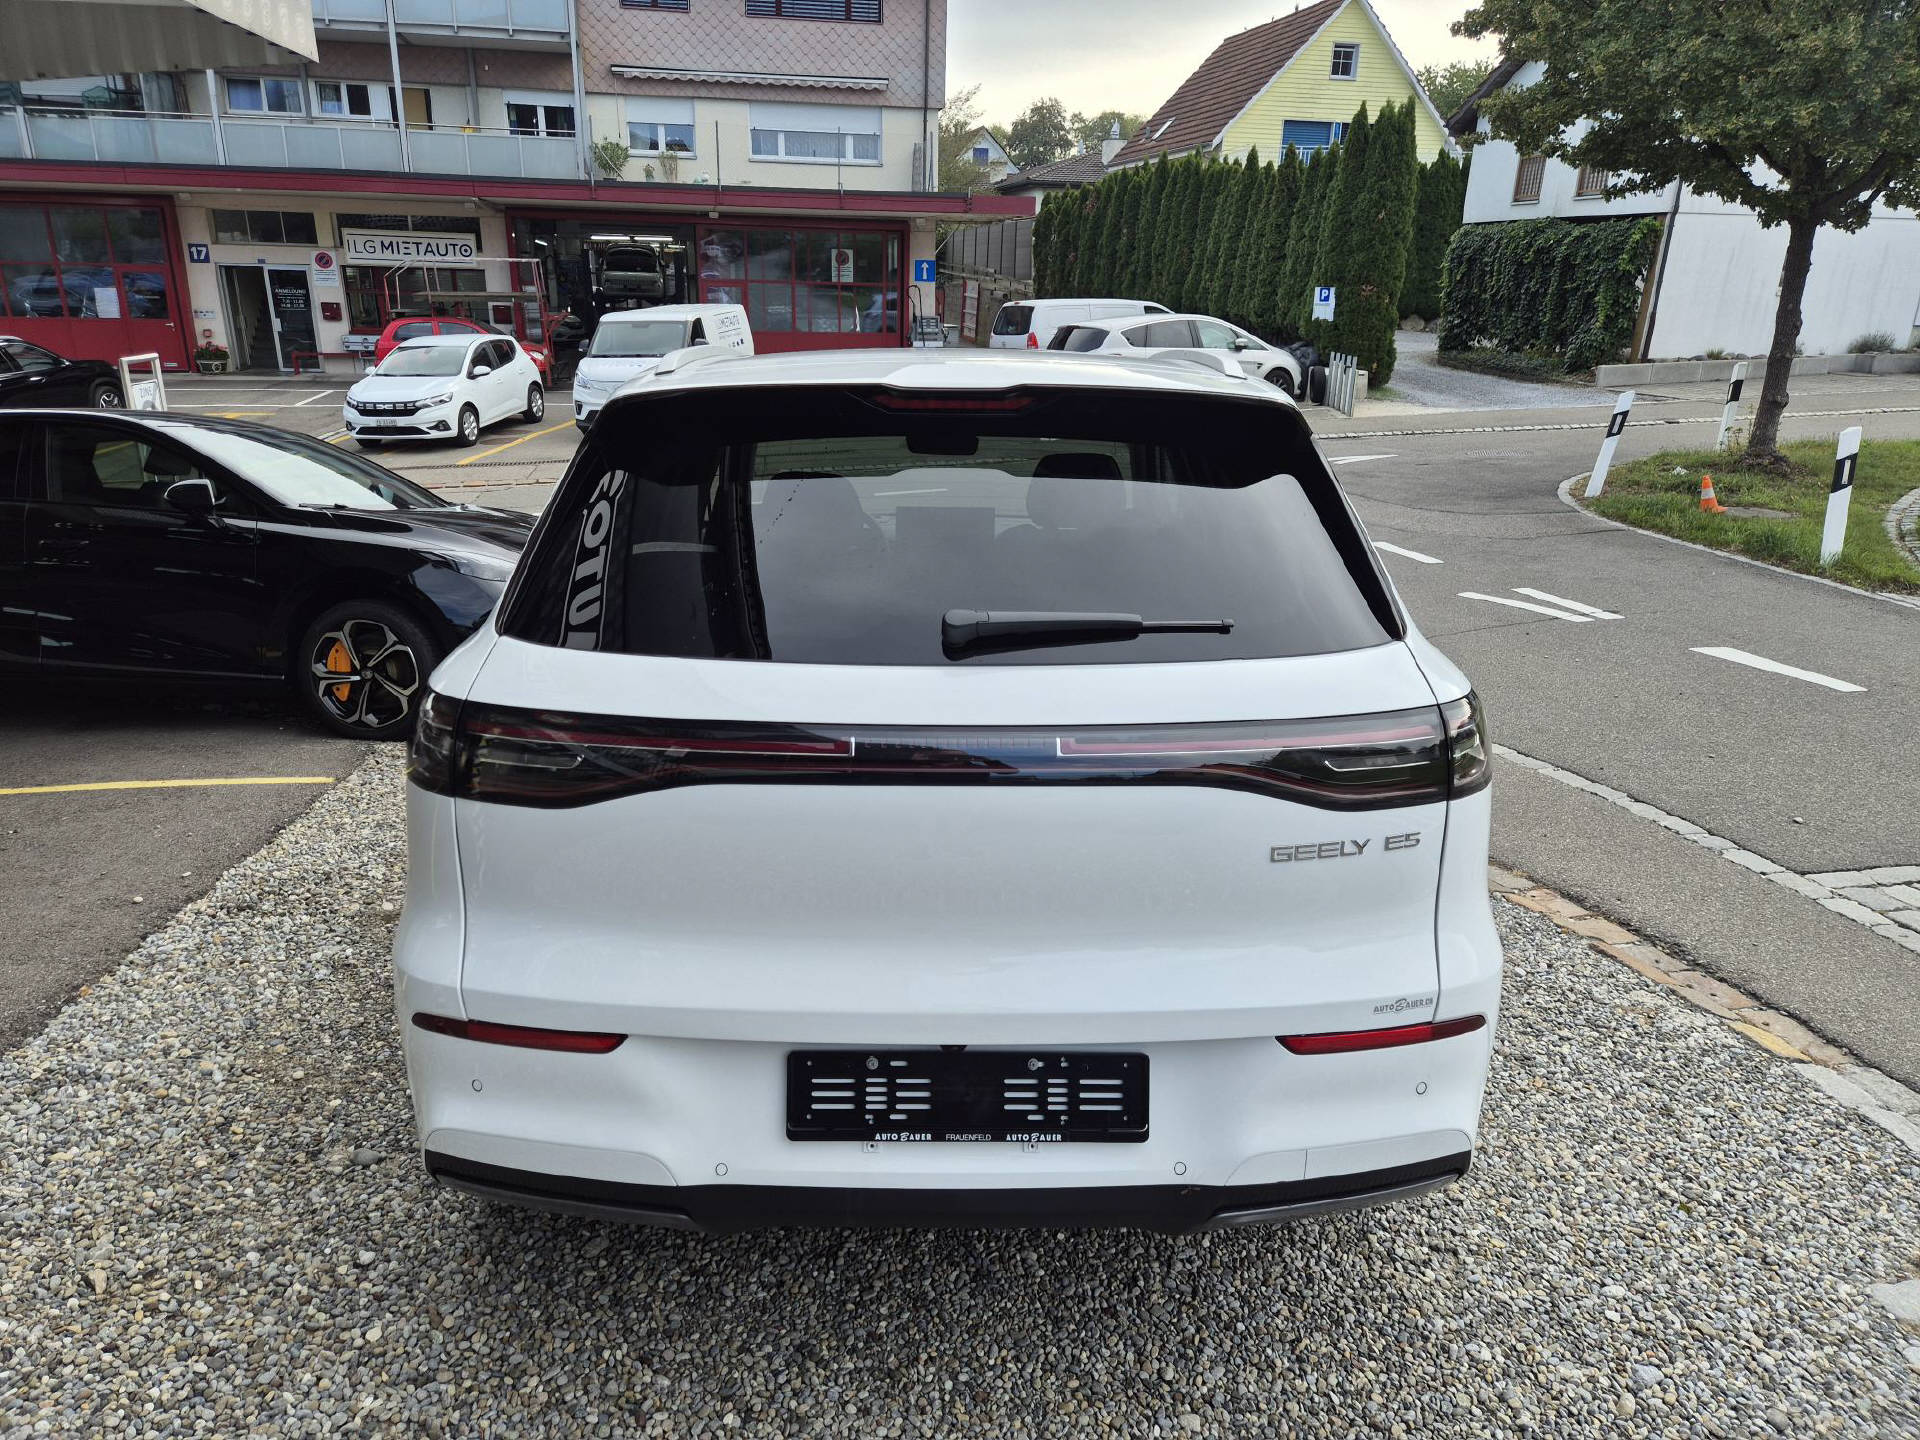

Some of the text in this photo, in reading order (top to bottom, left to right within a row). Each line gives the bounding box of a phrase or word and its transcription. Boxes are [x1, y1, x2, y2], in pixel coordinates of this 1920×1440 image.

[189, 246, 208, 260] 17
[346, 239, 473, 258] ILG MIETAUTO
[1321, 289, 1329, 301] P
[1269, 831, 1421, 863] GEELY E5
[945, 1133, 992, 1141] FRAUENFELD
